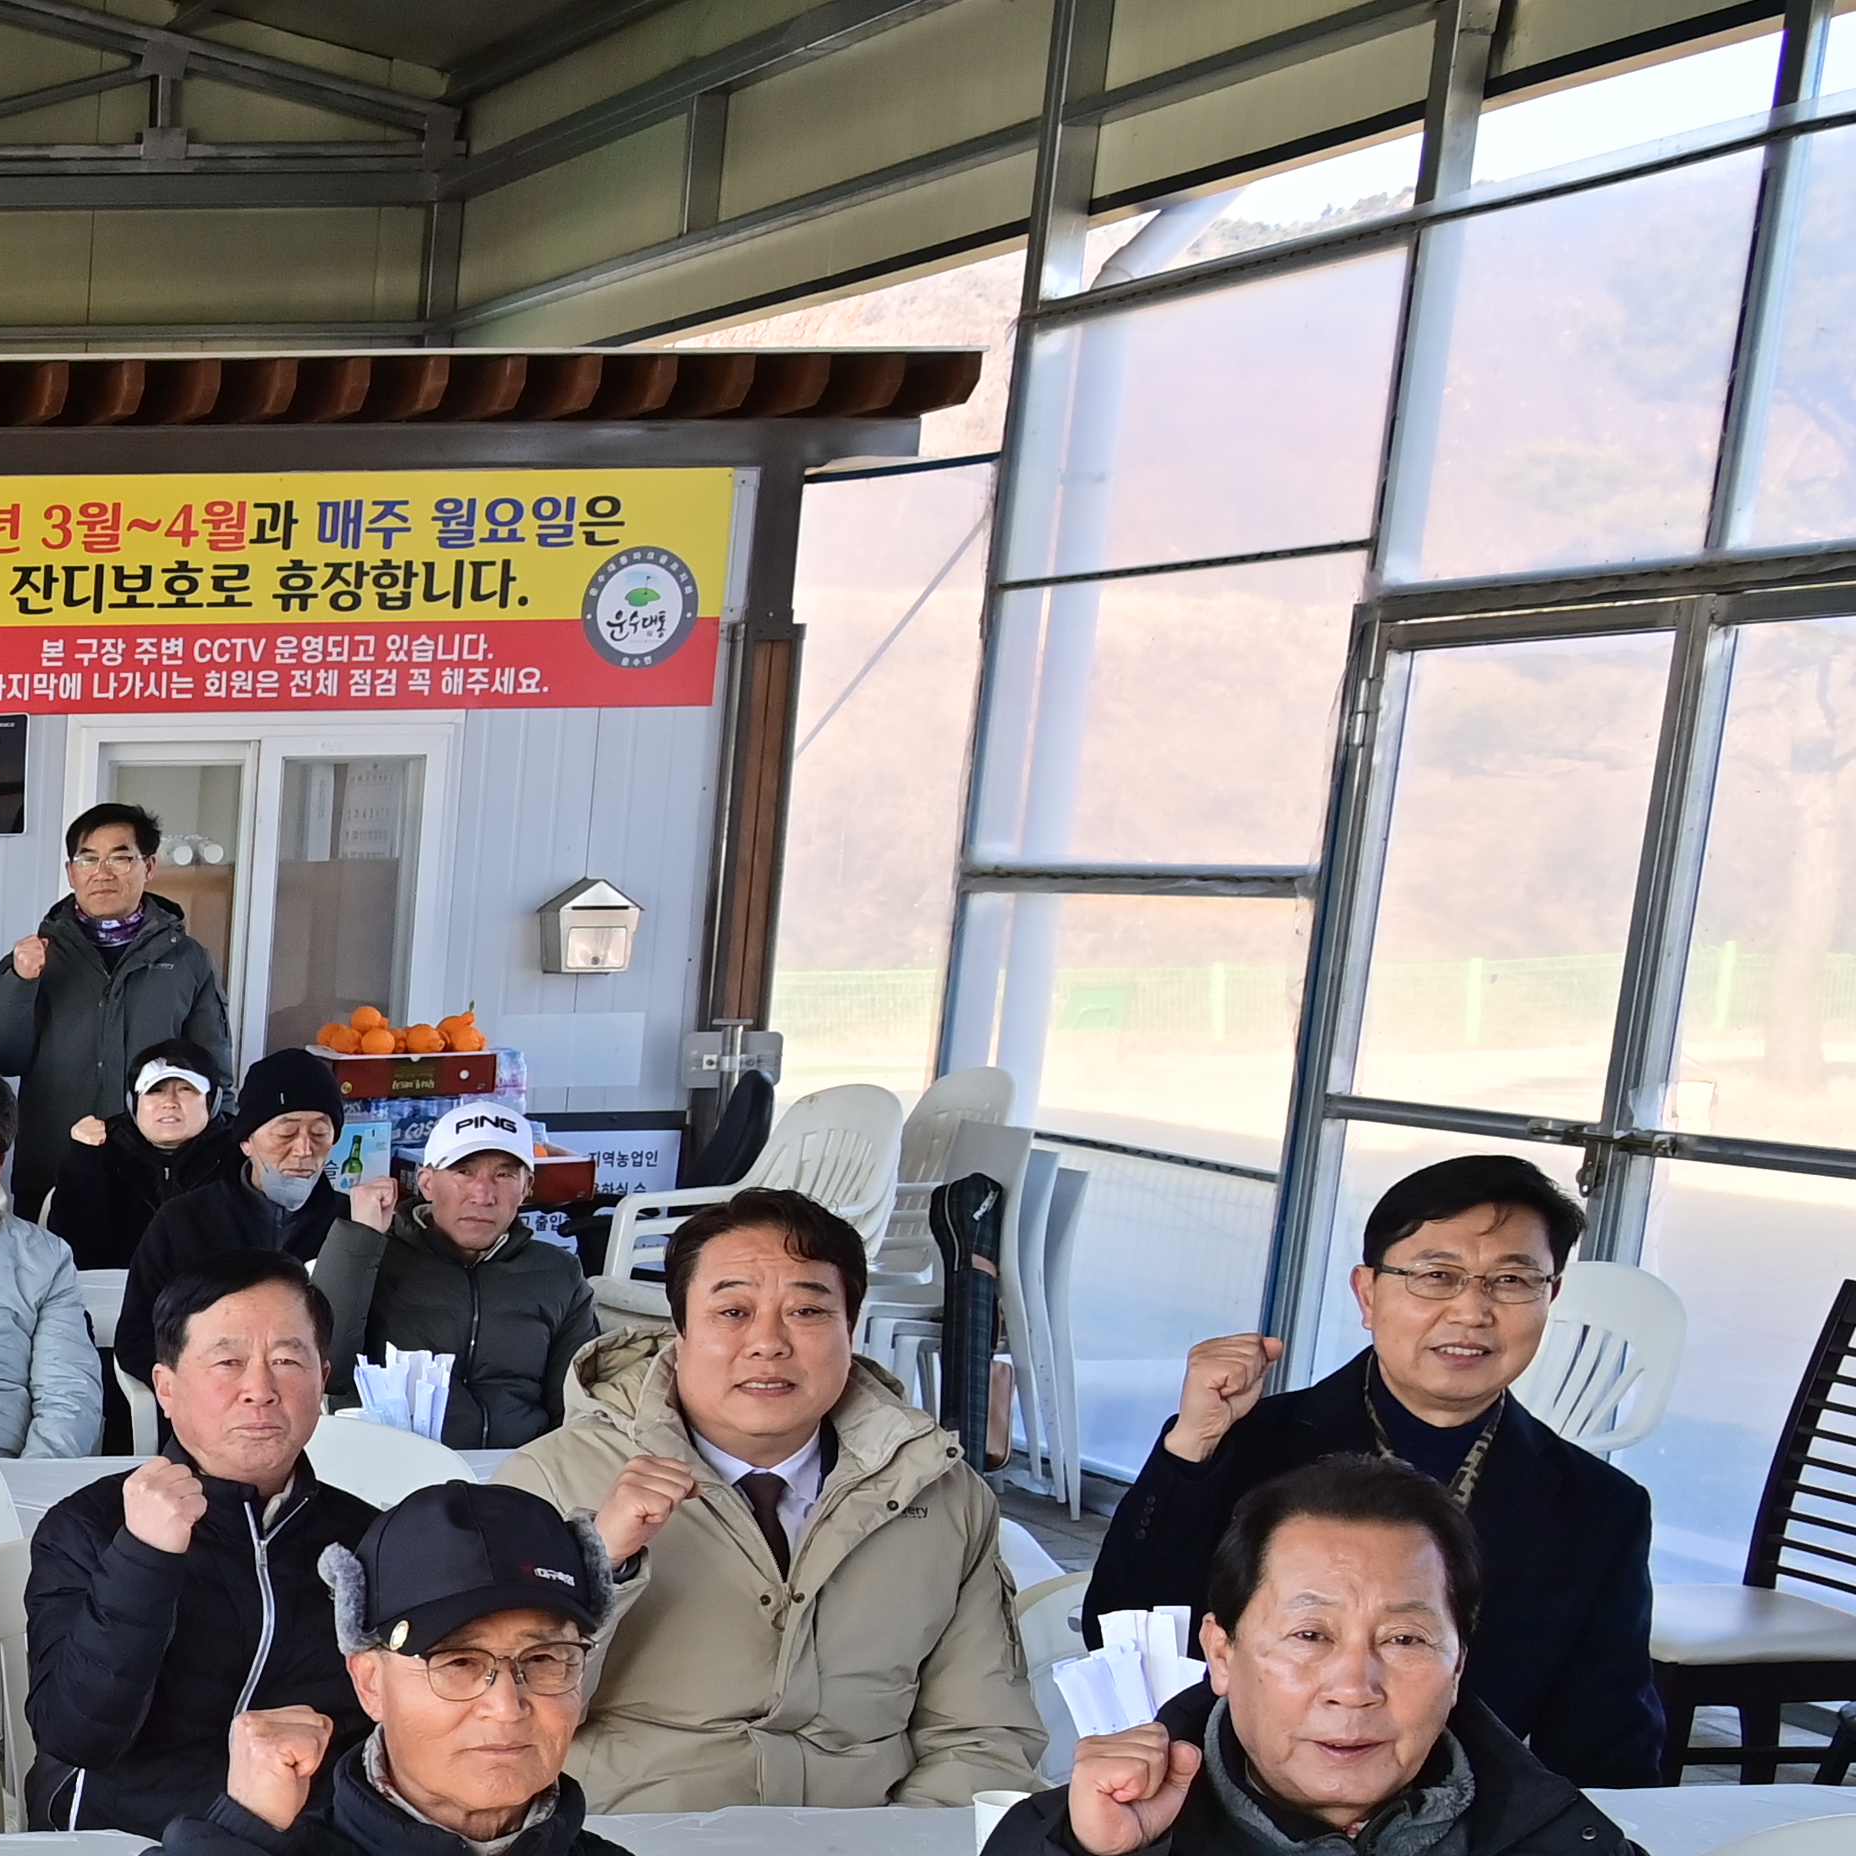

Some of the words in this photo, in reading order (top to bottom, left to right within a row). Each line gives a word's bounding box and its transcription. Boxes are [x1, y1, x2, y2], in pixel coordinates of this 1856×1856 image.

[41, 499, 299, 552] 3월~4월과
[316, 498, 412, 549] 매주
[431, 495, 626, 548] 월요일은
[9, 559, 253, 614] 잔디보호로
[272, 556, 529, 611] 휴장합니다.
[606, 610, 666, 641] 운수대통
[41, 639, 64, 667] 본
[74, 638, 126, 667] 구장
[134, 637, 184, 666] 주변
[193, 637, 267, 663] CCTV
[274, 634, 376, 664] 운영되고
[386, 633, 494, 663] 있습니다.
[93, 671, 195, 700] 나가시는
[204, 669, 280, 698] 회원은
[289, 669, 339, 698] 전체
[349, 668, 398, 697] 점검
[408, 668, 432, 696] 꼭
[441, 666, 550, 696] 해주세요.
[455, 1115, 517, 1135] PING
[589, 1150, 659, 1168] 지역농업인
[535, 1214, 571, 1231] 출입
